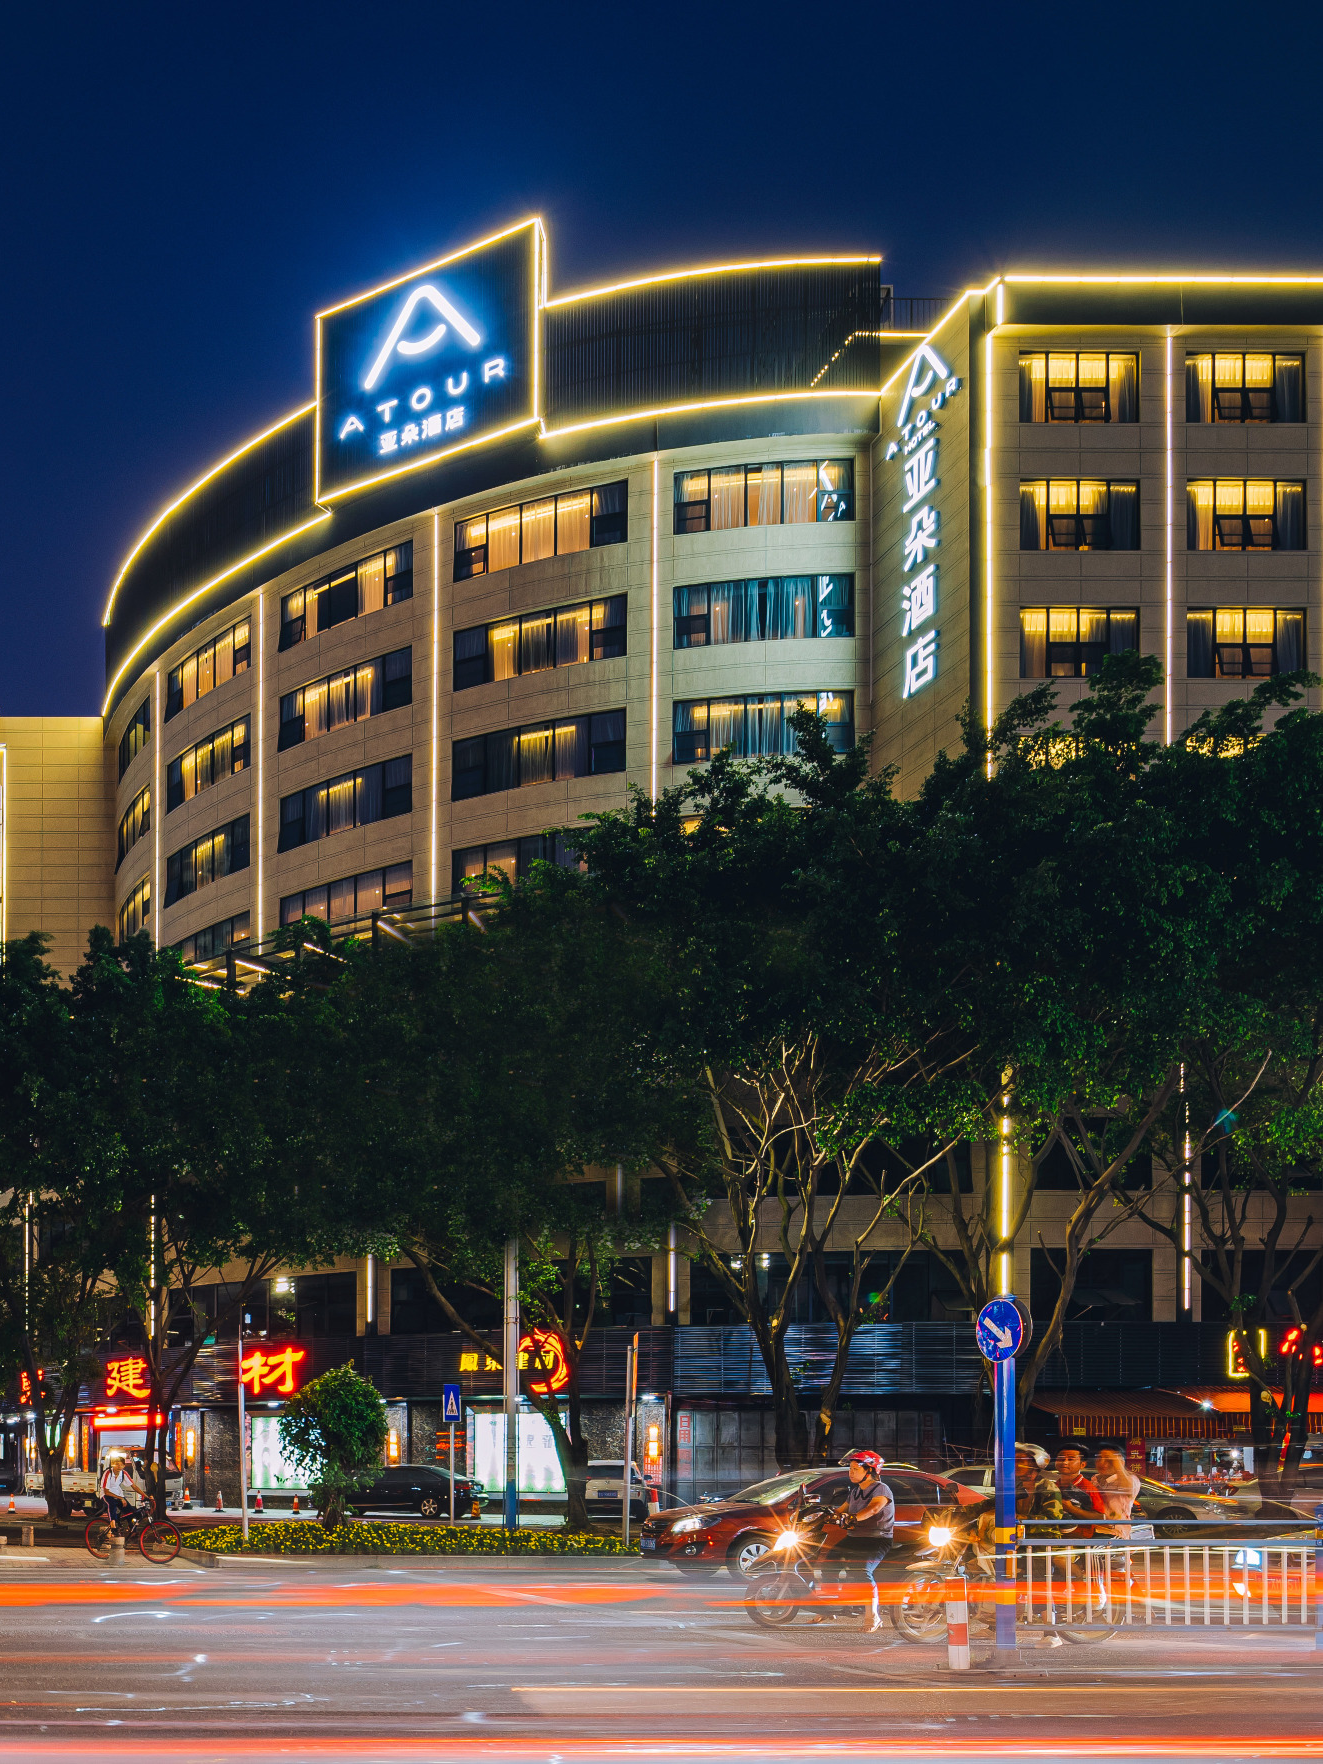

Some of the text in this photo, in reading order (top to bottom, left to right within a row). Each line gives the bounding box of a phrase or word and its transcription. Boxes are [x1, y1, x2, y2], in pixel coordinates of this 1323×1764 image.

[340, 358, 505, 440] ATOUR
[379, 407, 465, 454] 亚朵酒店
[885, 377, 958, 460] ATOUR
[904, 420, 936, 455] HOTEL
[902, 438, 937, 699] 亚朵酒店
